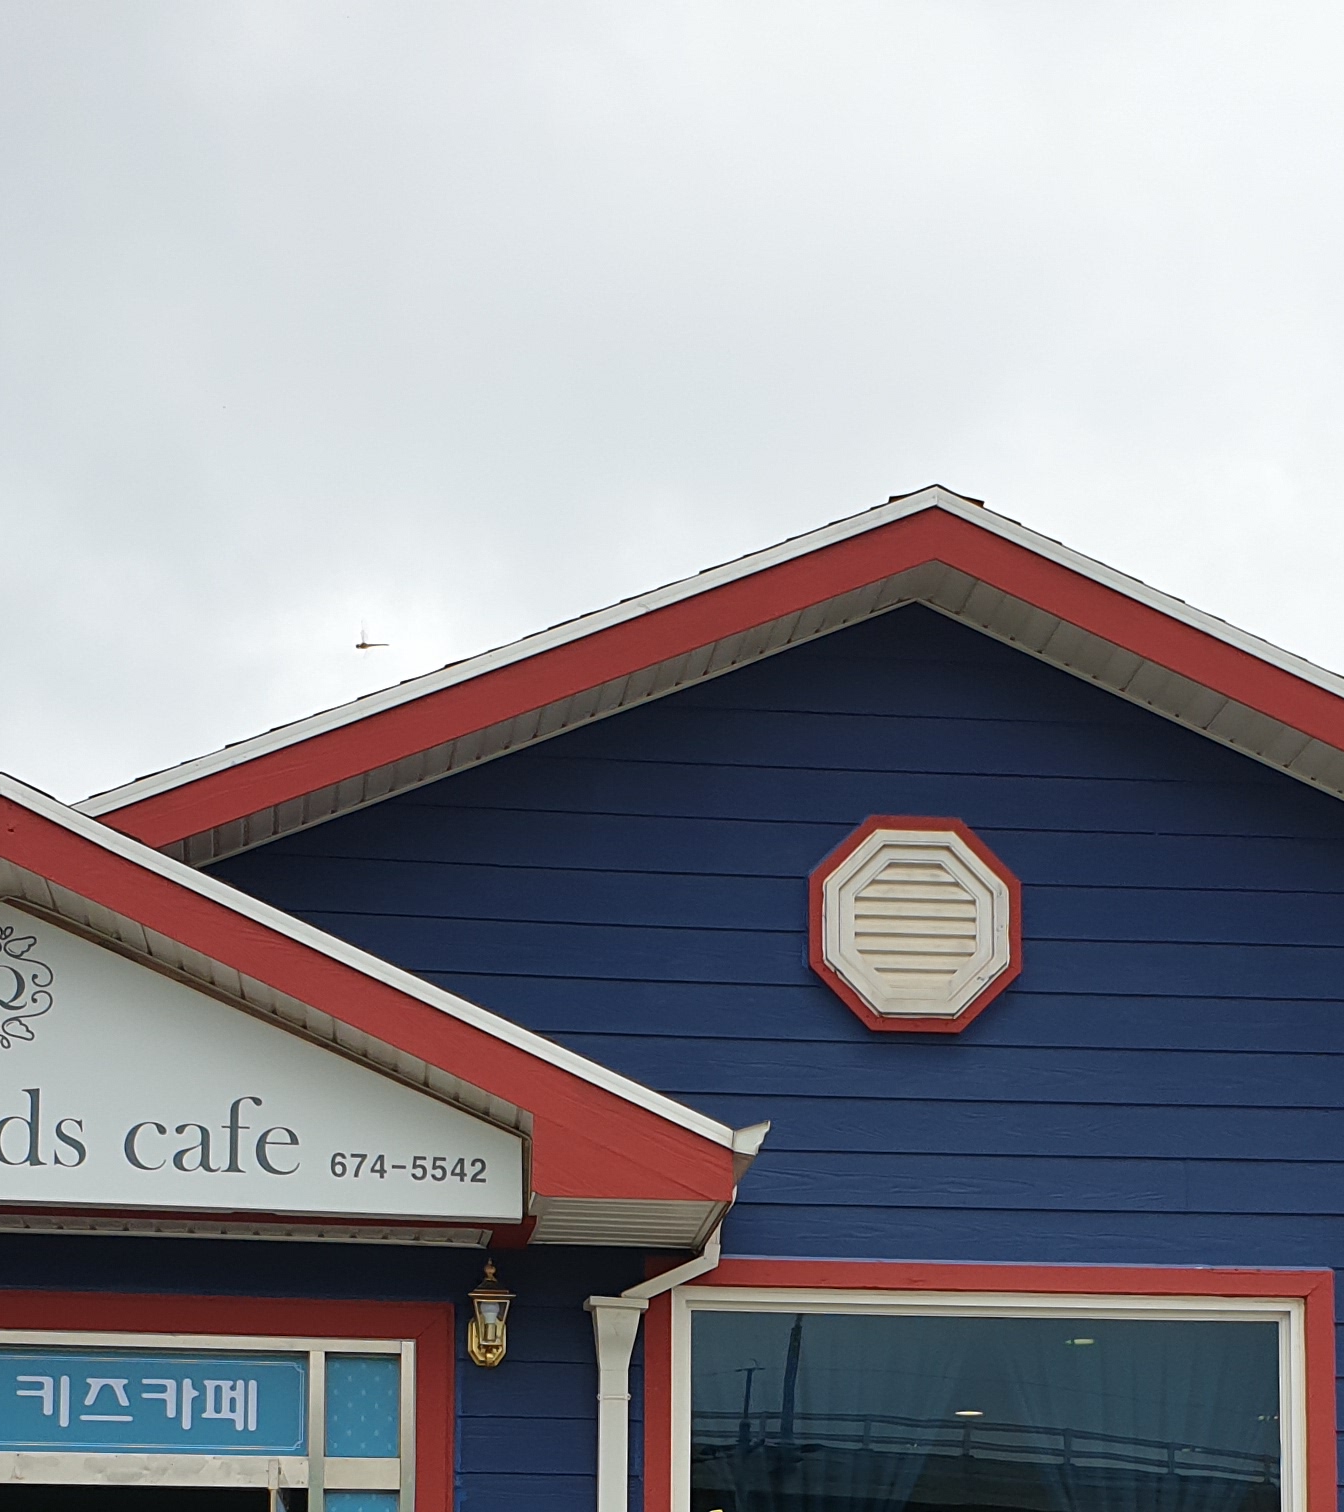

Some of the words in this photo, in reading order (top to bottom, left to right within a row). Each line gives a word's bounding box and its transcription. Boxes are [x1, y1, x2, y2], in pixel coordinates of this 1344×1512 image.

[123, 1096, 301, 1175] cafe
[329, 1151, 488, 1183] 674-5542
[16, 1375, 258, 1431] 키즈카페
